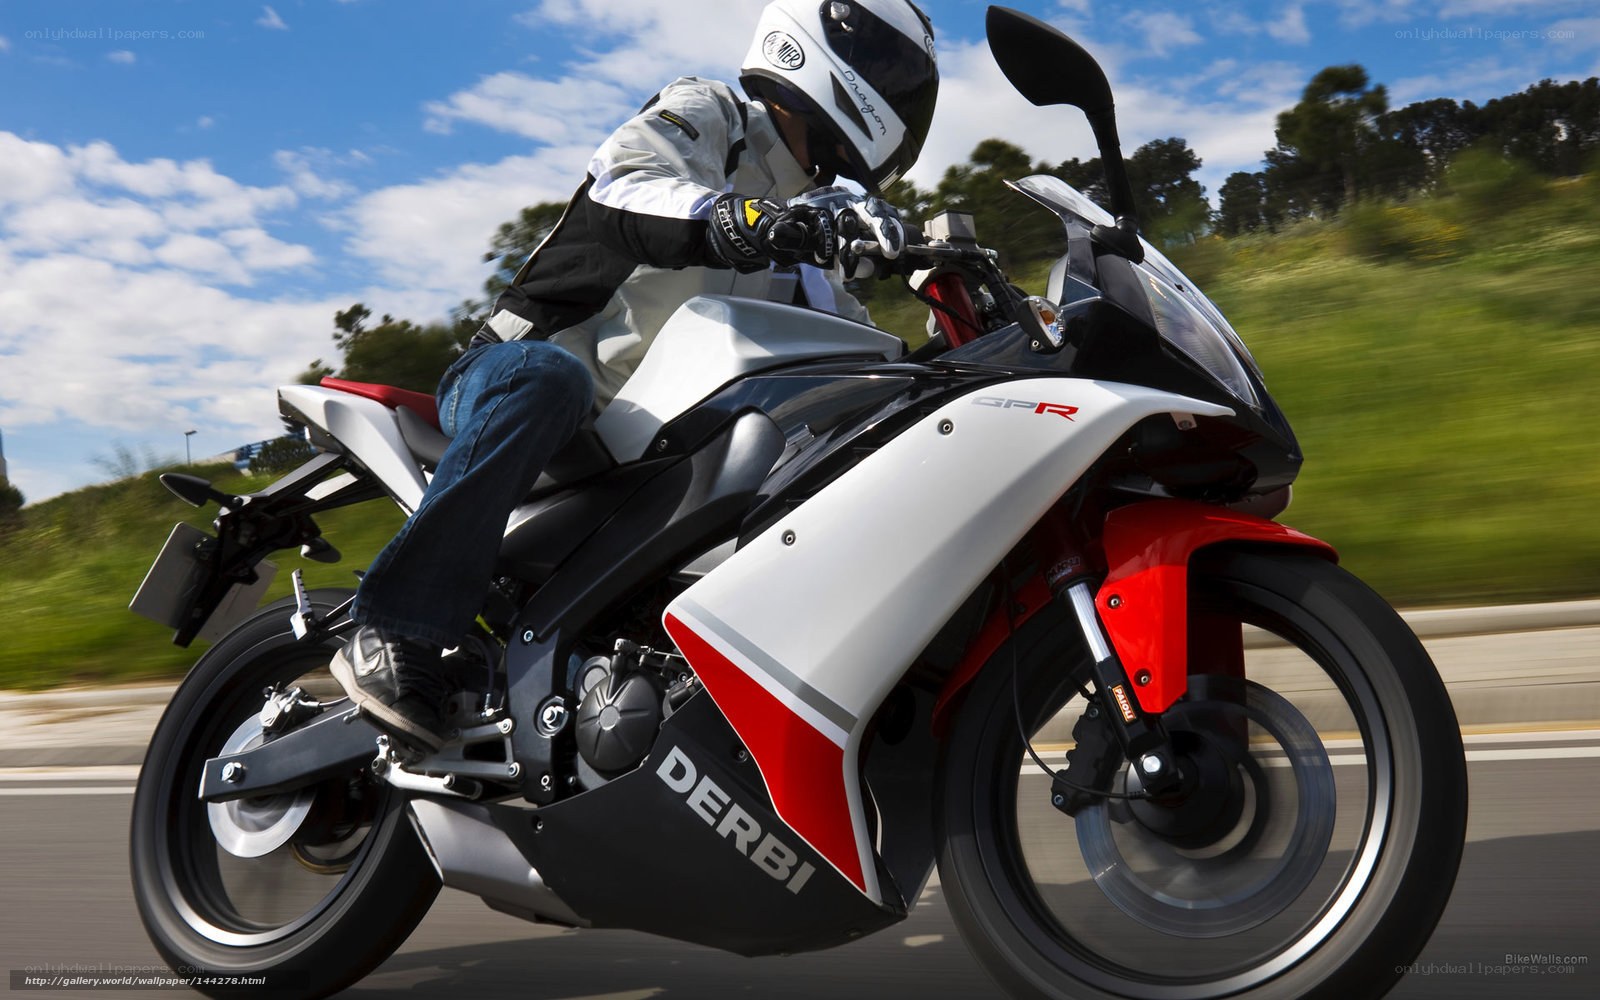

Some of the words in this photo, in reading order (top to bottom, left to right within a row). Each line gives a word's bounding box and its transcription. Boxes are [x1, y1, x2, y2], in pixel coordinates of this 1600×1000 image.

[766, 34, 804, 69] PRMIER
[844, 70, 887, 136] Dragon
[971, 396, 1080, 422] GPR
[1114, 688, 1134, 719] PAIOLI
[655, 745, 817, 895] DERBI
